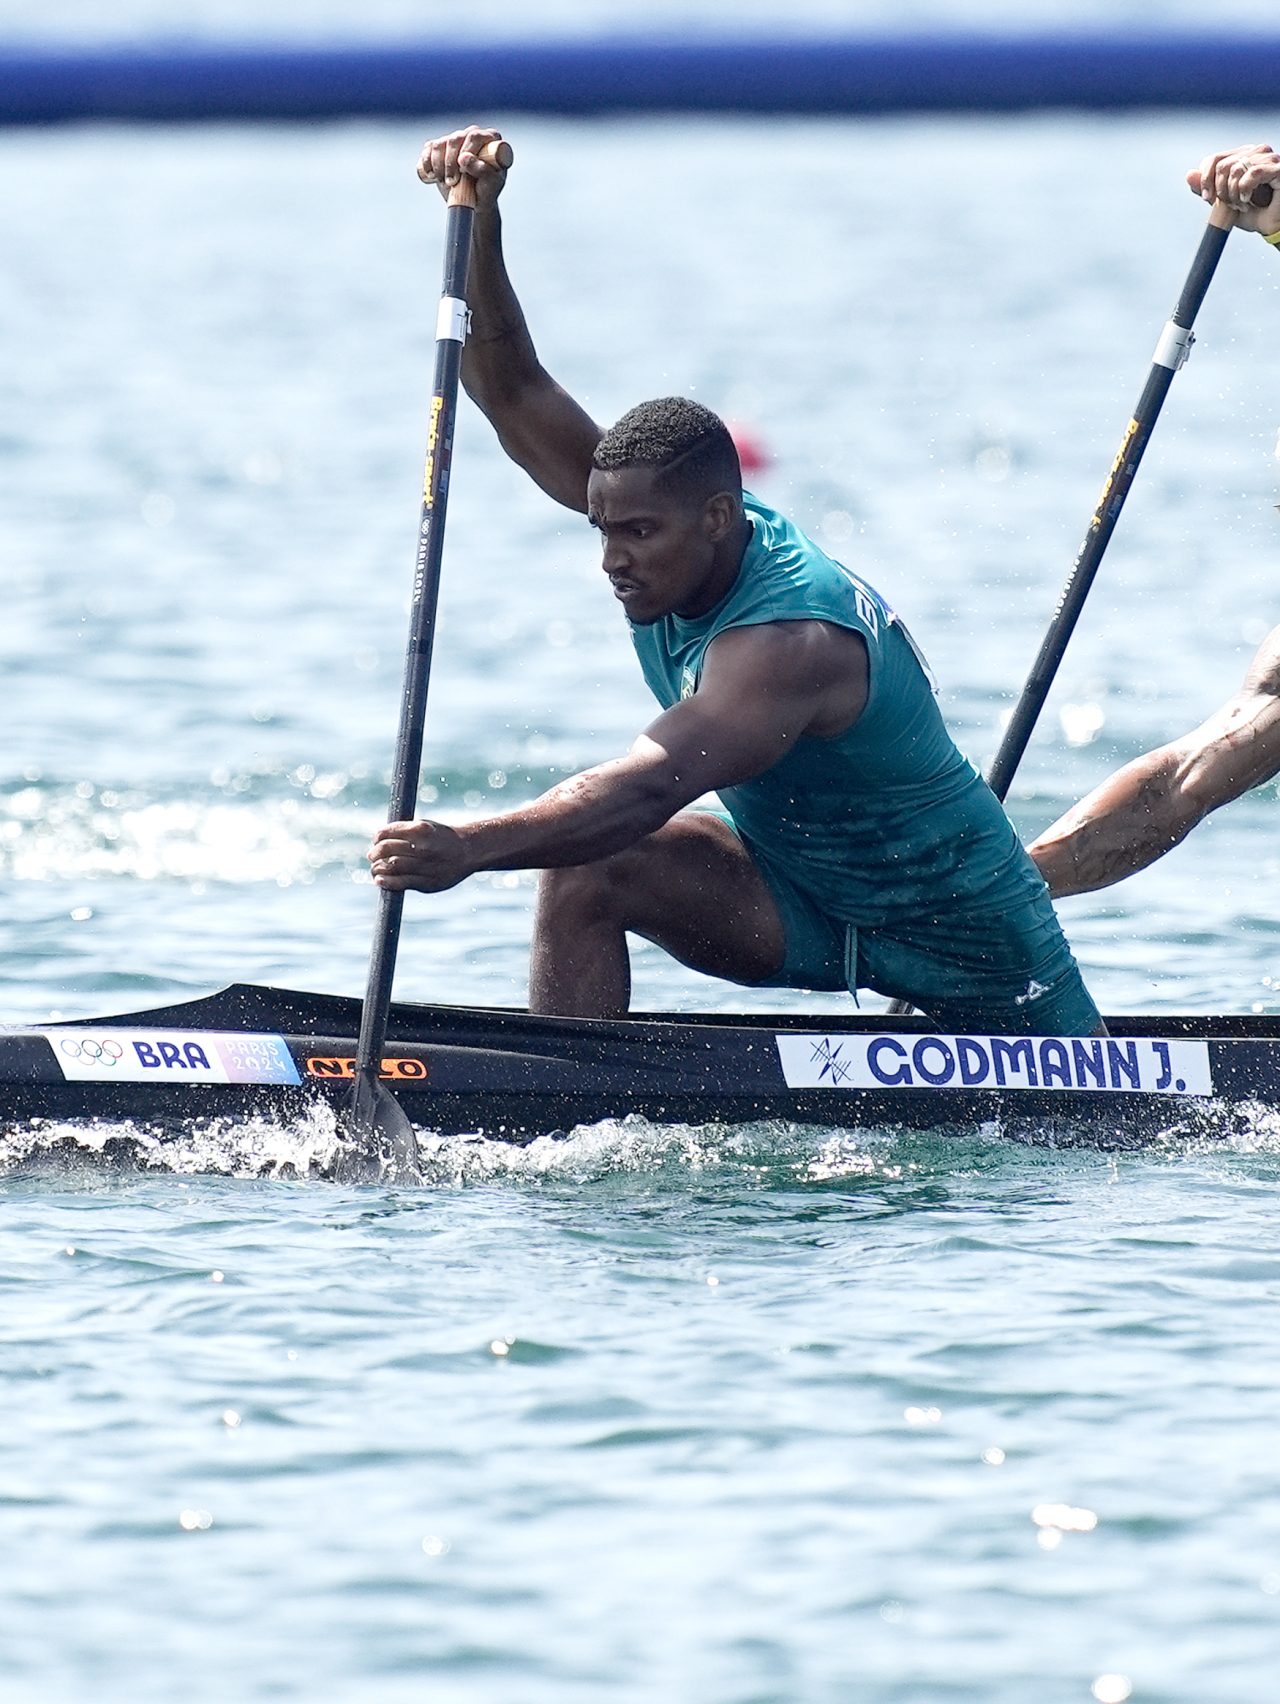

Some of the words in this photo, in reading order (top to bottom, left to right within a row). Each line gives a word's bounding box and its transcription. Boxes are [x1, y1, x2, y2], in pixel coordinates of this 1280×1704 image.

[132, 1041, 211, 1070] BRA
[224, 1041, 279, 1057] PARIS
[232, 1056, 286, 1072] 2024
[312, 1060, 423, 1077] NO
[866, 1036, 1141, 1090] GODMANN
[1151, 1041, 1187, 1092] J.
